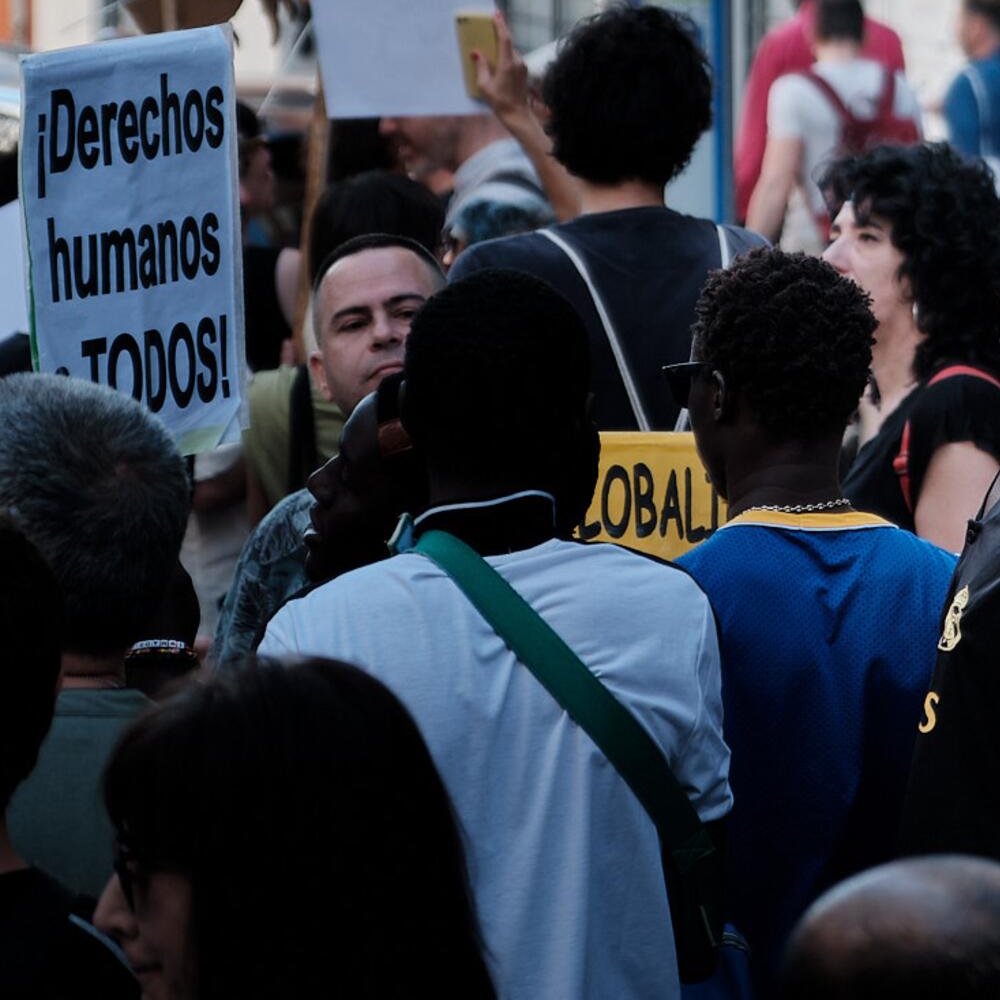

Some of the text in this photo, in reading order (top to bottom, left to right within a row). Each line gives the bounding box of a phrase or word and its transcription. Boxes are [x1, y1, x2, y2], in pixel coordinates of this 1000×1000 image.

[37, 73, 225, 200] ¡Derechos
[47, 212, 221, 303] humanos
[81, 314, 231, 414] TODOS!
